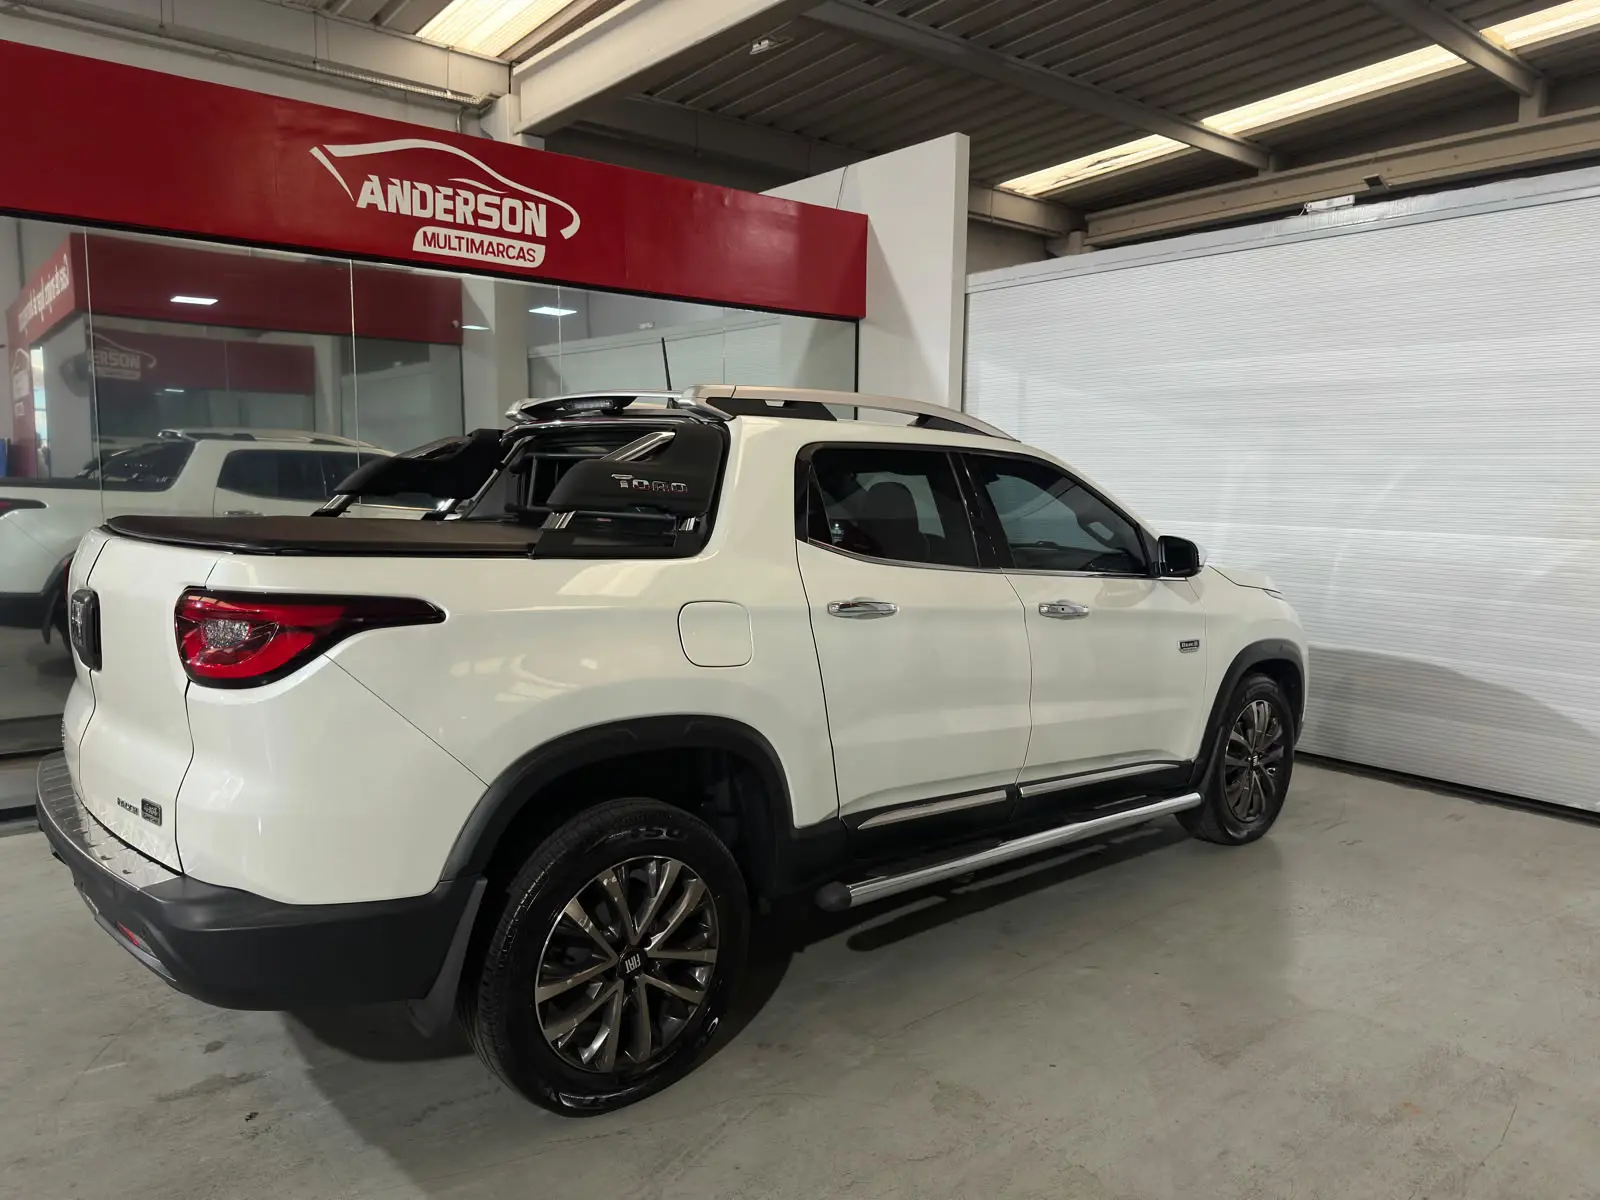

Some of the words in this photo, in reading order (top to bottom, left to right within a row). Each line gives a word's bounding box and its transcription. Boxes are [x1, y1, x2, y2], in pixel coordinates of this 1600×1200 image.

[356, 174, 547, 238] ANDERSON
[422, 230, 536, 263] MULTIMARCAS
[611, 473, 688, 493] TORO
[624, 953, 641, 974] FIAT
